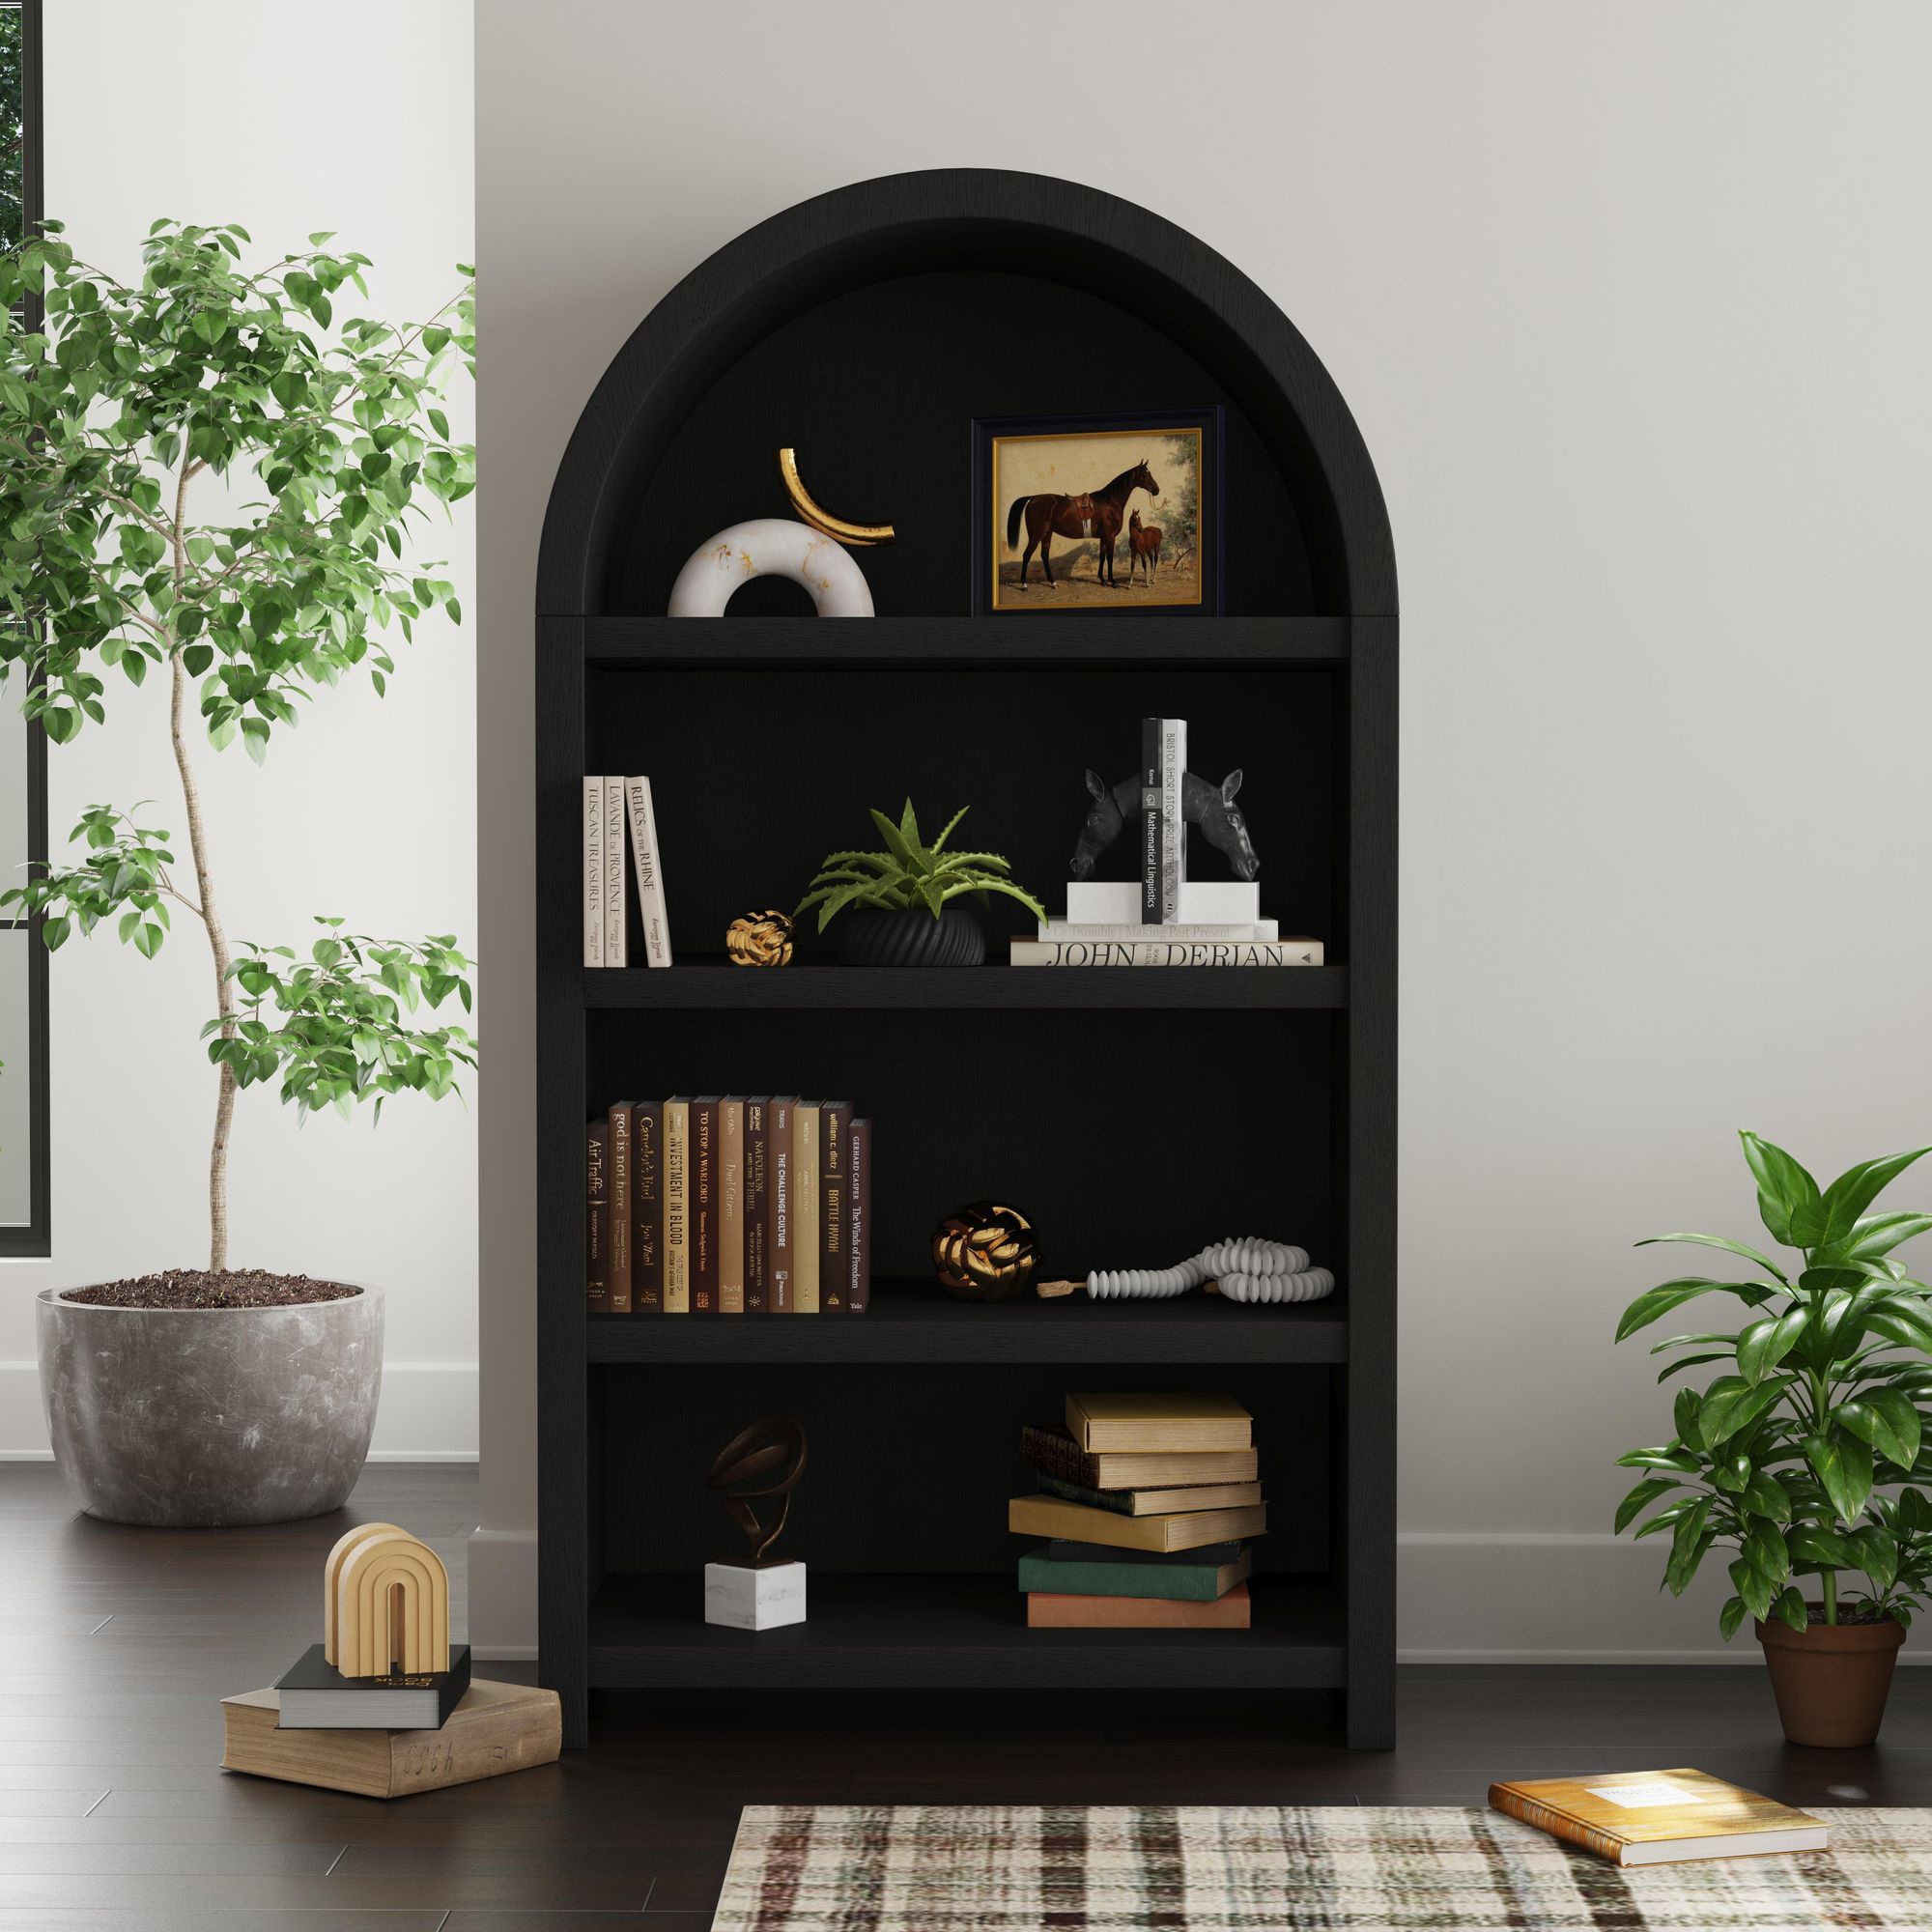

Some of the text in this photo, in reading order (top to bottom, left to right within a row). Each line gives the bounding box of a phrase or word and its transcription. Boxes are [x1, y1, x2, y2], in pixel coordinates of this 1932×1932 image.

[1165, 733, 1176, 763] BRISTOL
[1165, 767, 1176, 792] SHORT
[610, 785, 621, 838] LAVANDE
[631, 786, 646, 826] RELICS
[636, 828, 643, 838] OF
[1165, 824, 1176, 844] PRIZE
[588, 786, 600, 911] TUSCAN TREASURES
[1146, 811, 1157, 908] Mathematical Linguistics
[610, 853, 621, 916] PROVENCE
[639, 853, 654, 891] RHINE
[1054, 924, 1230, 941] Cy Twombly Making Past Present
[1046, 943, 1286, 966] JOHN DERIAN
[612, 1113, 629, 1138] god
[699, 1111, 709, 1124] TO
[616, 1141, 629, 1152] is
[639, 1117, 654, 1174] Camelot's
[699, 1126, 709, 1149] STOP
[588, 1139, 604, 1195] Air Traffic
[615, 1154, 628, 1178] not
[669, 1138, 683, 1199] INVESTMENT
[725, 1163, 737, 1185] Dual
[754, 1141, 764, 1193] NAPOLEON
[830, 1151, 838, 1169] dietz
[615, 1180, 628, 1209] here
[699, 1159, 709, 1203] WARLORD
[669, 1202, 683, 1211] IN
[778, 1153, 786, 1247] THE CHALLENGE CULTURE
[669, 1215, 683, 1245] BLOOD
[828, 1189, 839, 1253] BATTLE HYMN
[851, 1207, 862, 1289] The Winds of Freedom
